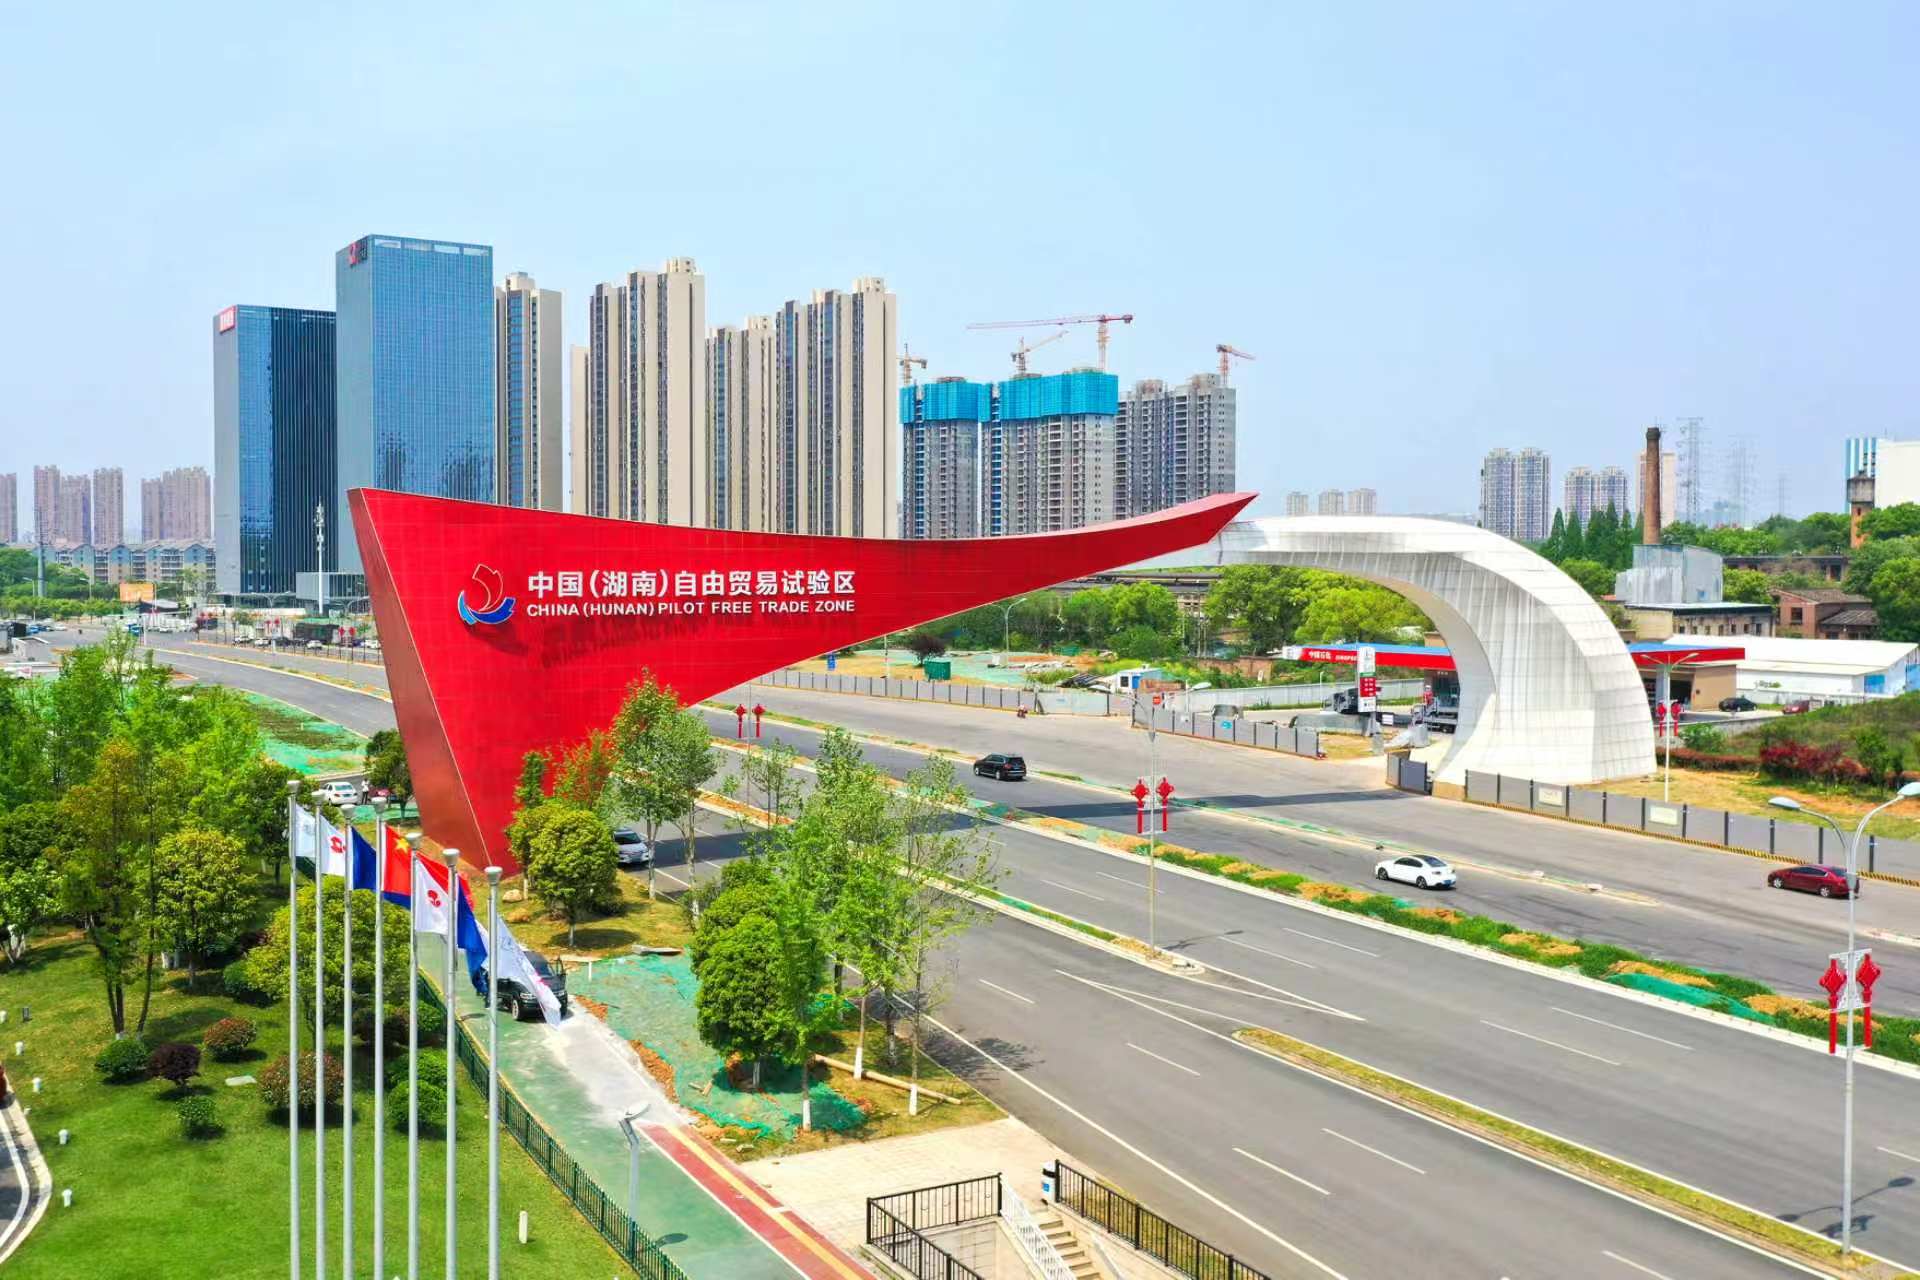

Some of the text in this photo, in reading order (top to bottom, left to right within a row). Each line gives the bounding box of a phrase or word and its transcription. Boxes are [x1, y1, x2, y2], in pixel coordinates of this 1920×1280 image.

[528, 569, 855, 598] 中国（湖南）自由贸易试验区
[527, 600, 855, 617] CHINA (HUNAN) PILOT FREE TRADE ZONE
